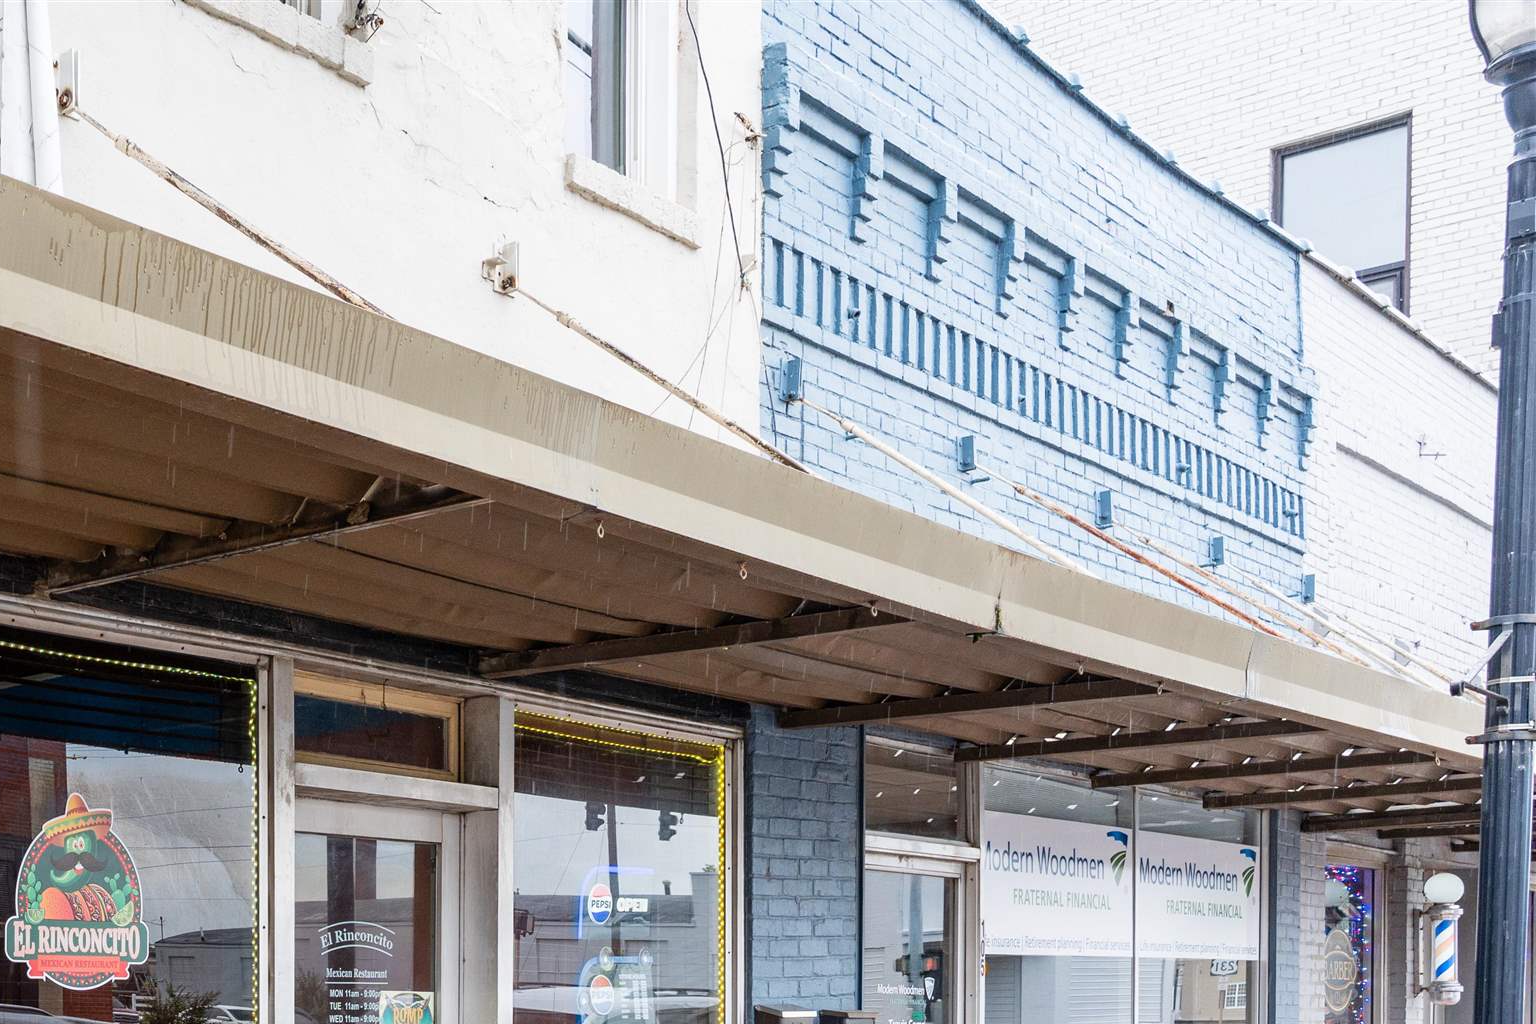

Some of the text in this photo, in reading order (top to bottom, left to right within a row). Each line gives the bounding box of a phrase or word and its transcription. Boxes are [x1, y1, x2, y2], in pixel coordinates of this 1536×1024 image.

[1036, 845, 1104, 880] Woodmen
[1139, 857, 1238, 892] Modern Woodmen
[591, 900, 611, 909] PEPSI
[616, 897, 649, 913] OPEN
[1013, 888, 1111, 911] FRATERNAL FINANCIAL
[1166, 899, 1243, 919] FRATERNAL FINANCIAL
[13, 920, 140, 960] EL RINCONCITO
[320, 928, 393, 950] El Rinconcito
[39, 959, 119, 969] MEXICAN RESTAURANT
[326, 968, 387, 979] Mexican Restaurant
[329, 990, 344, 998] MON
[344, 990, 359, 998] 11am
[364, 990, 380, 999] 9:00p
[877, 983, 925, 996] Modern Woodmen
[329, 1002, 342, 1010] TUE
[344, 1002, 359, 1010] 11am
[364, 1002, 380, 1012] 9:00p
[329, 1015, 344, 1023] WED
[344, 1015, 359, 1023] 11am
[364, 1015, 380, 1024] 9:00p
